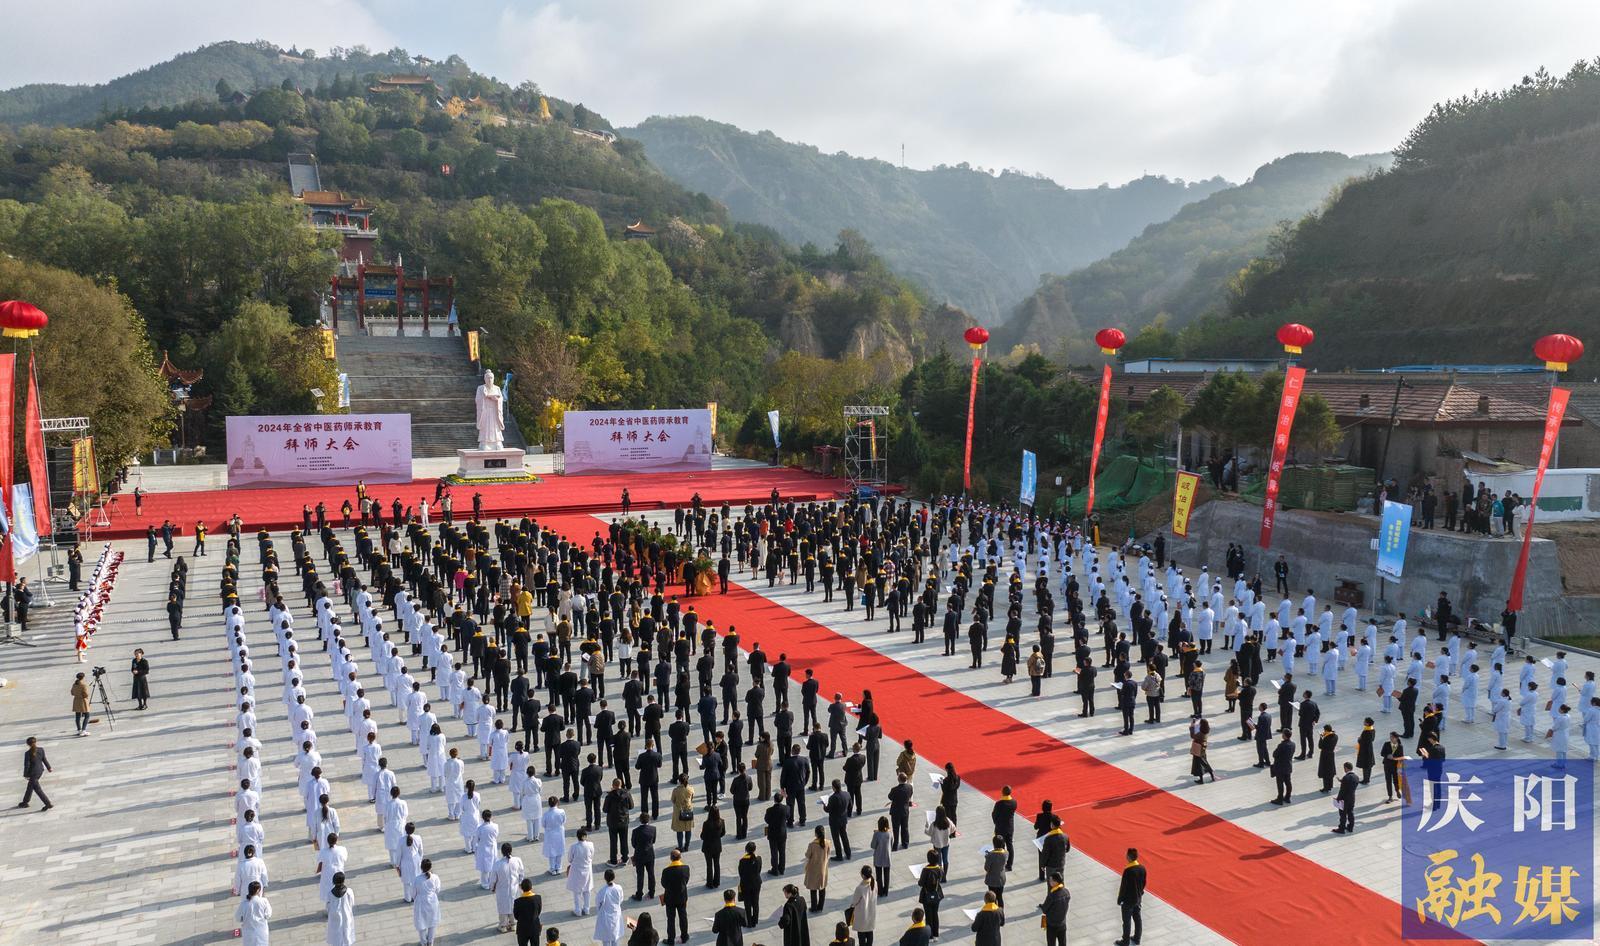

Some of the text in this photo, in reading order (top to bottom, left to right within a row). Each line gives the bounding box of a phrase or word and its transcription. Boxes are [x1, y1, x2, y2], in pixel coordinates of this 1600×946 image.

[258, 420, 383, 433] 2024年全省中医药师承教育
[589, 415, 689, 427] 2024年全省中医药师承教育
[610, 429, 671, 443] 拜师大会
[283, 436, 360, 453] 拜师大会
